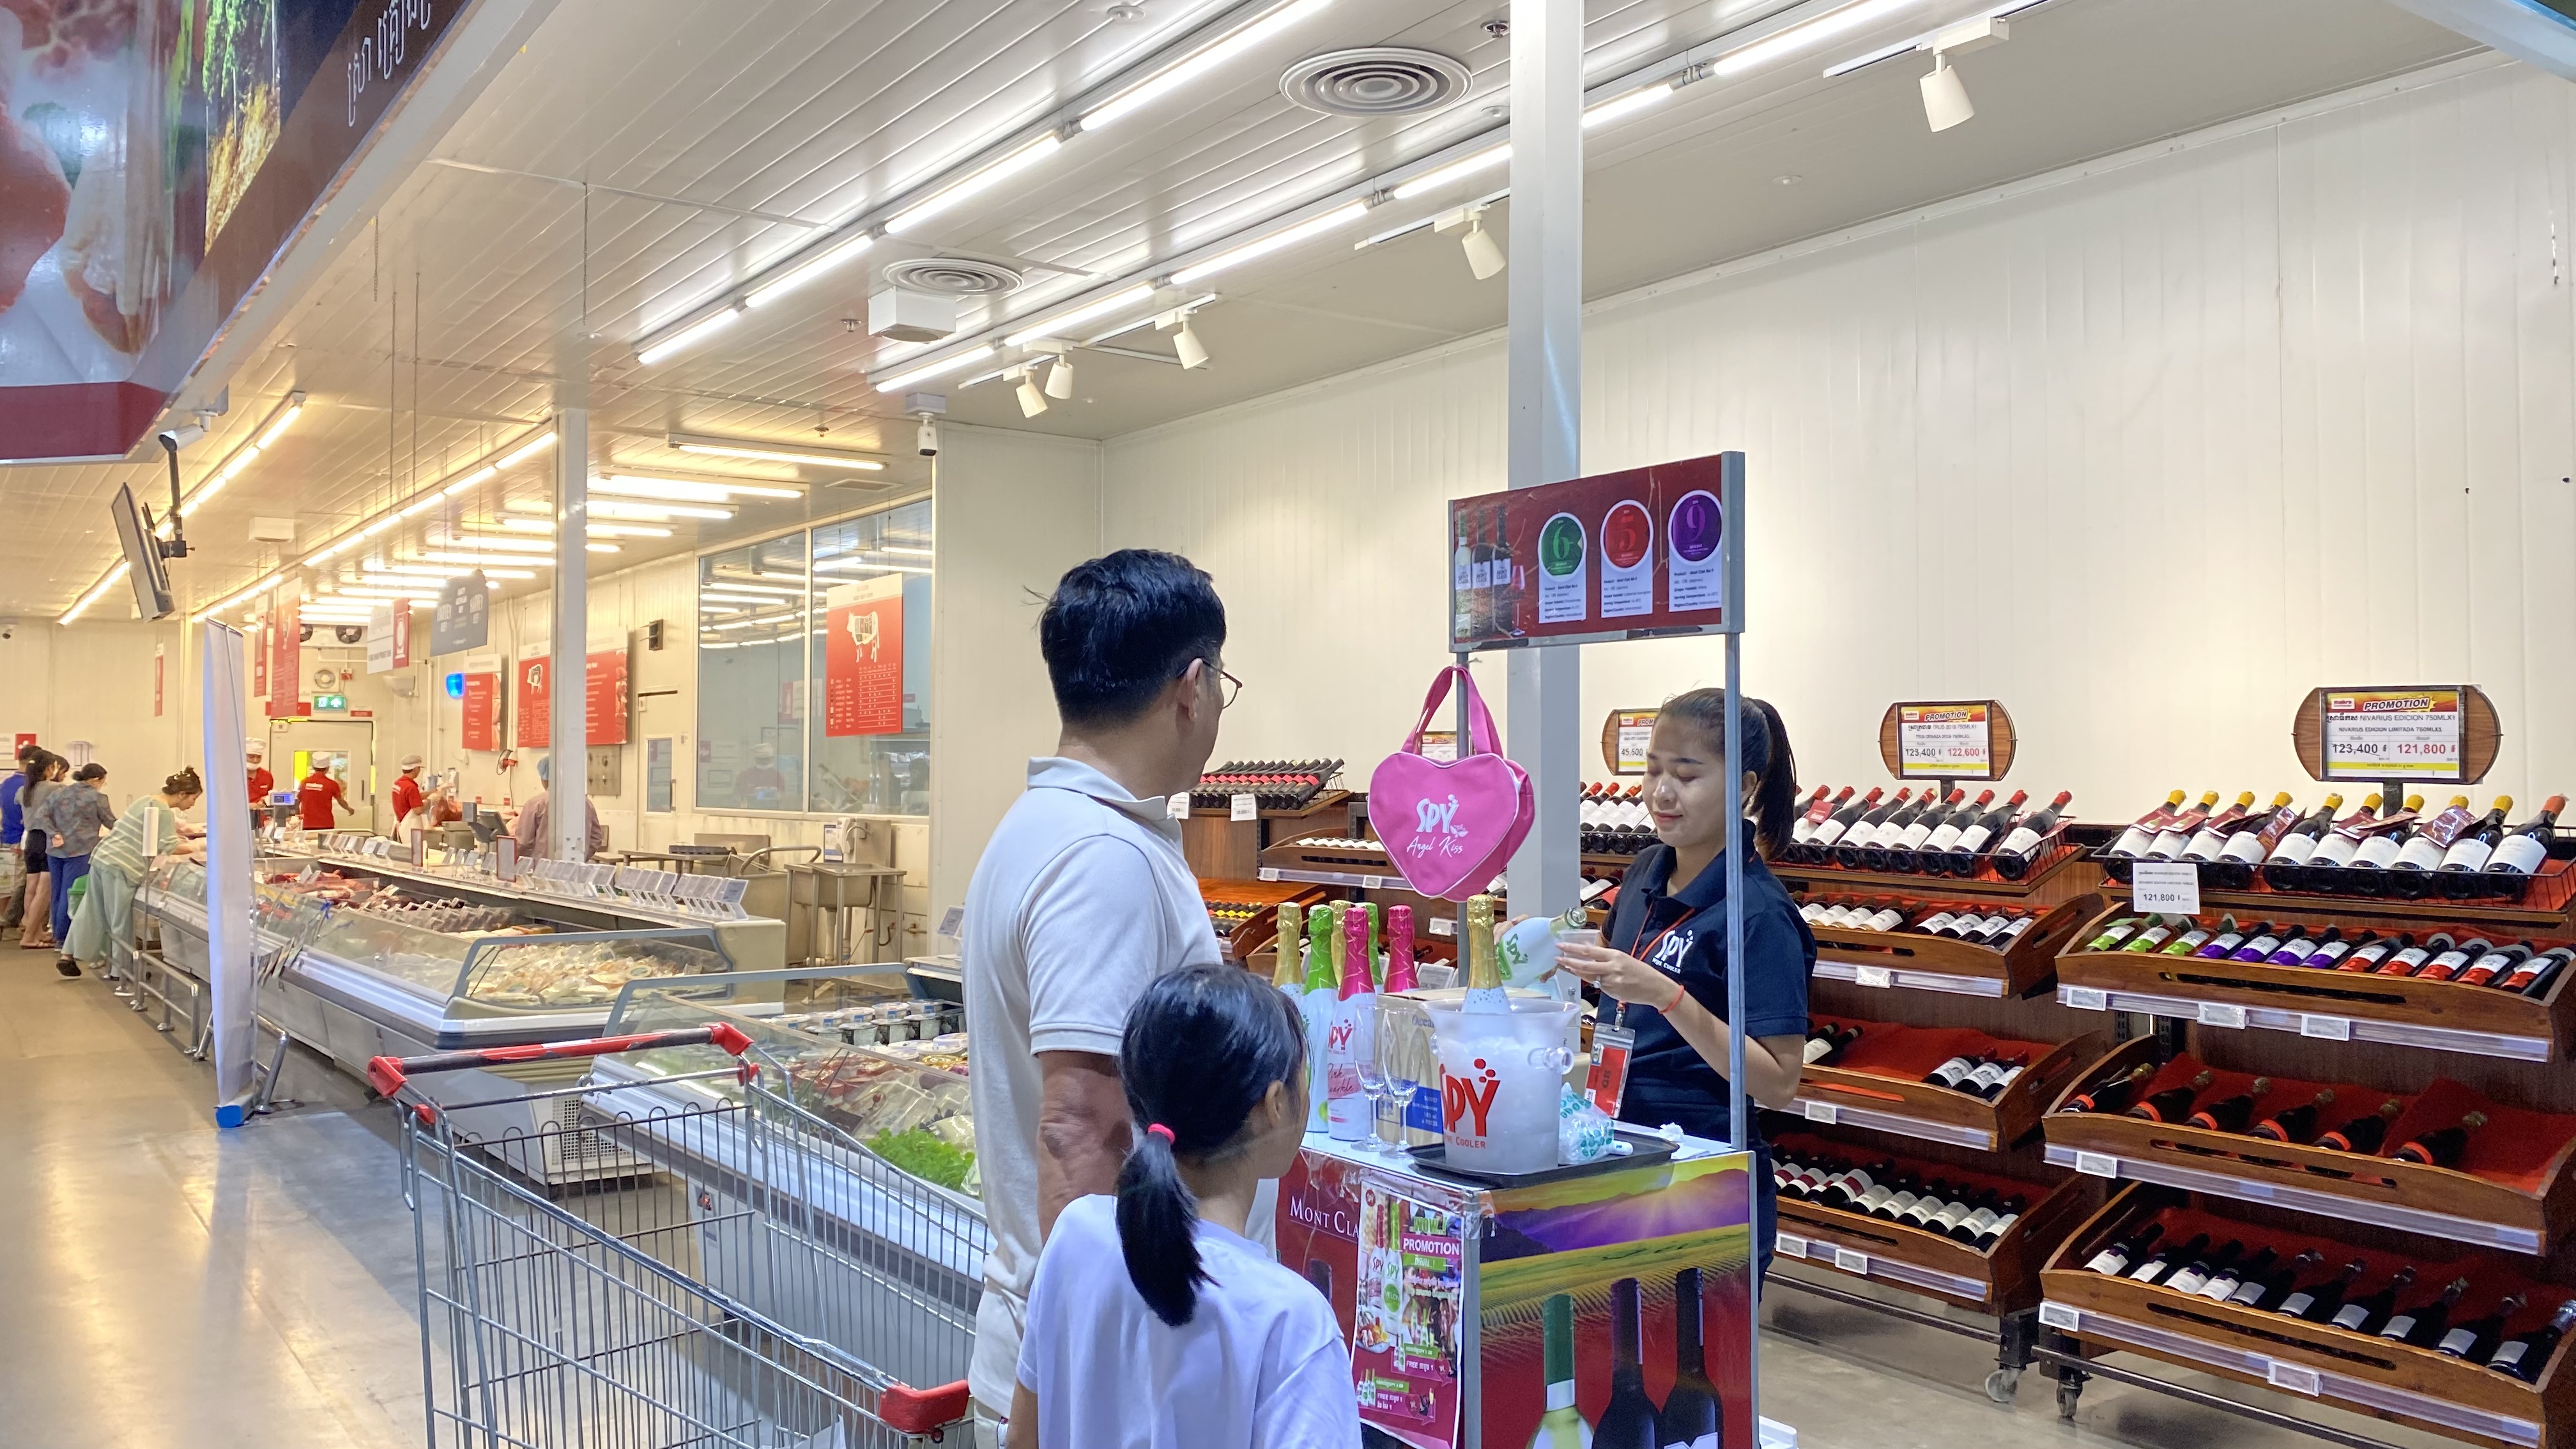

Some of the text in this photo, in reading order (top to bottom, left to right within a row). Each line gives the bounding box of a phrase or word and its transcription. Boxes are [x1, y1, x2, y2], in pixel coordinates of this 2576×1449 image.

[1686, 505, 1706, 542] 9
[1552, 523, 1570, 560] 6
[1619, 515, 1636, 551] 5
[2365, 698, 2428, 710] PROMOTION
[1925, 711, 1967, 721] PROMOTION
[1905, 747, 1936, 758] 123,400
[1947, 747, 1979, 758] 122,600
[2332, 743, 2379, 755] 123,400
[2396, 744, 2446, 756] 121,800
[1416, 795, 1459, 834] SPY
[1407, 836, 1464, 858] Angel Kiss
[2143, 894, 2175, 902] 121,800
[1506, 933, 1529, 965] SPY
[1655, 930, 1693, 968] SPY
[1328, 1020, 1353, 1051] PY
[1455, 1136, 1486, 1149] COOLER
[1290, 1195, 1360, 1239] MONT CLA
[1403, 1238, 1460, 1255] PROMOTION
[1387, 1262, 1400, 1279] SPY
[1406, 1360, 1418, 1369] FREE
[1377, 1392, 1388, 1401] FREE
